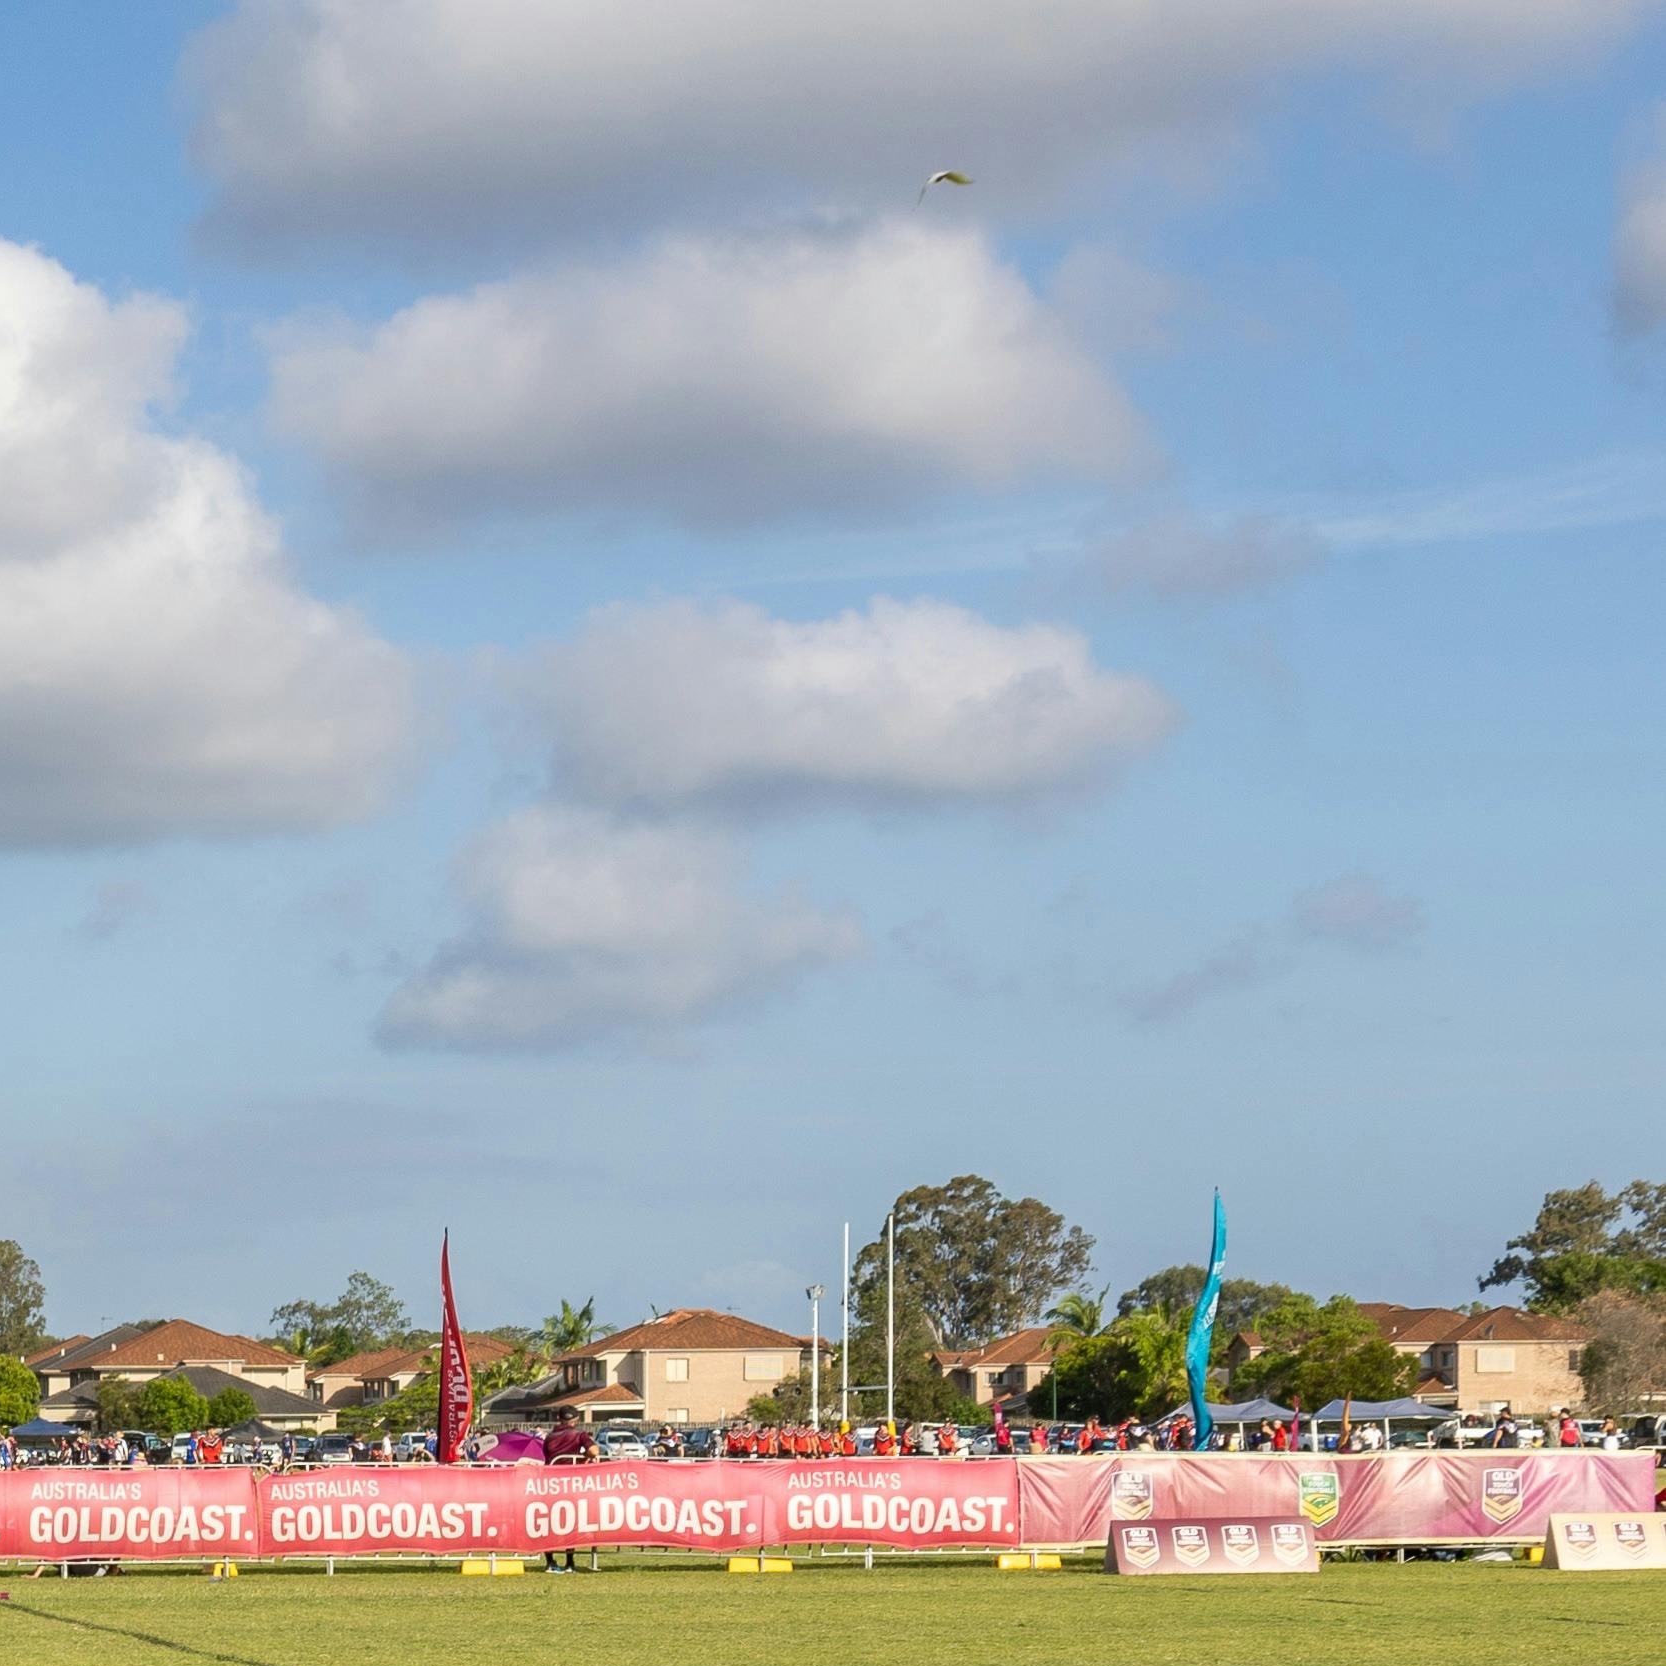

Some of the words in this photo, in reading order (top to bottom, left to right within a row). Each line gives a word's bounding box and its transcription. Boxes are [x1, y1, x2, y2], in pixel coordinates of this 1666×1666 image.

[524, 1472, 639, 1497] AUSTRALIA'S
[786, 1471, 902, 1491] AUSTRALIA'S
[1492, 1471, 1514, 1481] QLD
[31, 1482, 142, 1501] AUSTRALIA'S
[269, 1479, 380, 1501] AUSTRALIA'S
